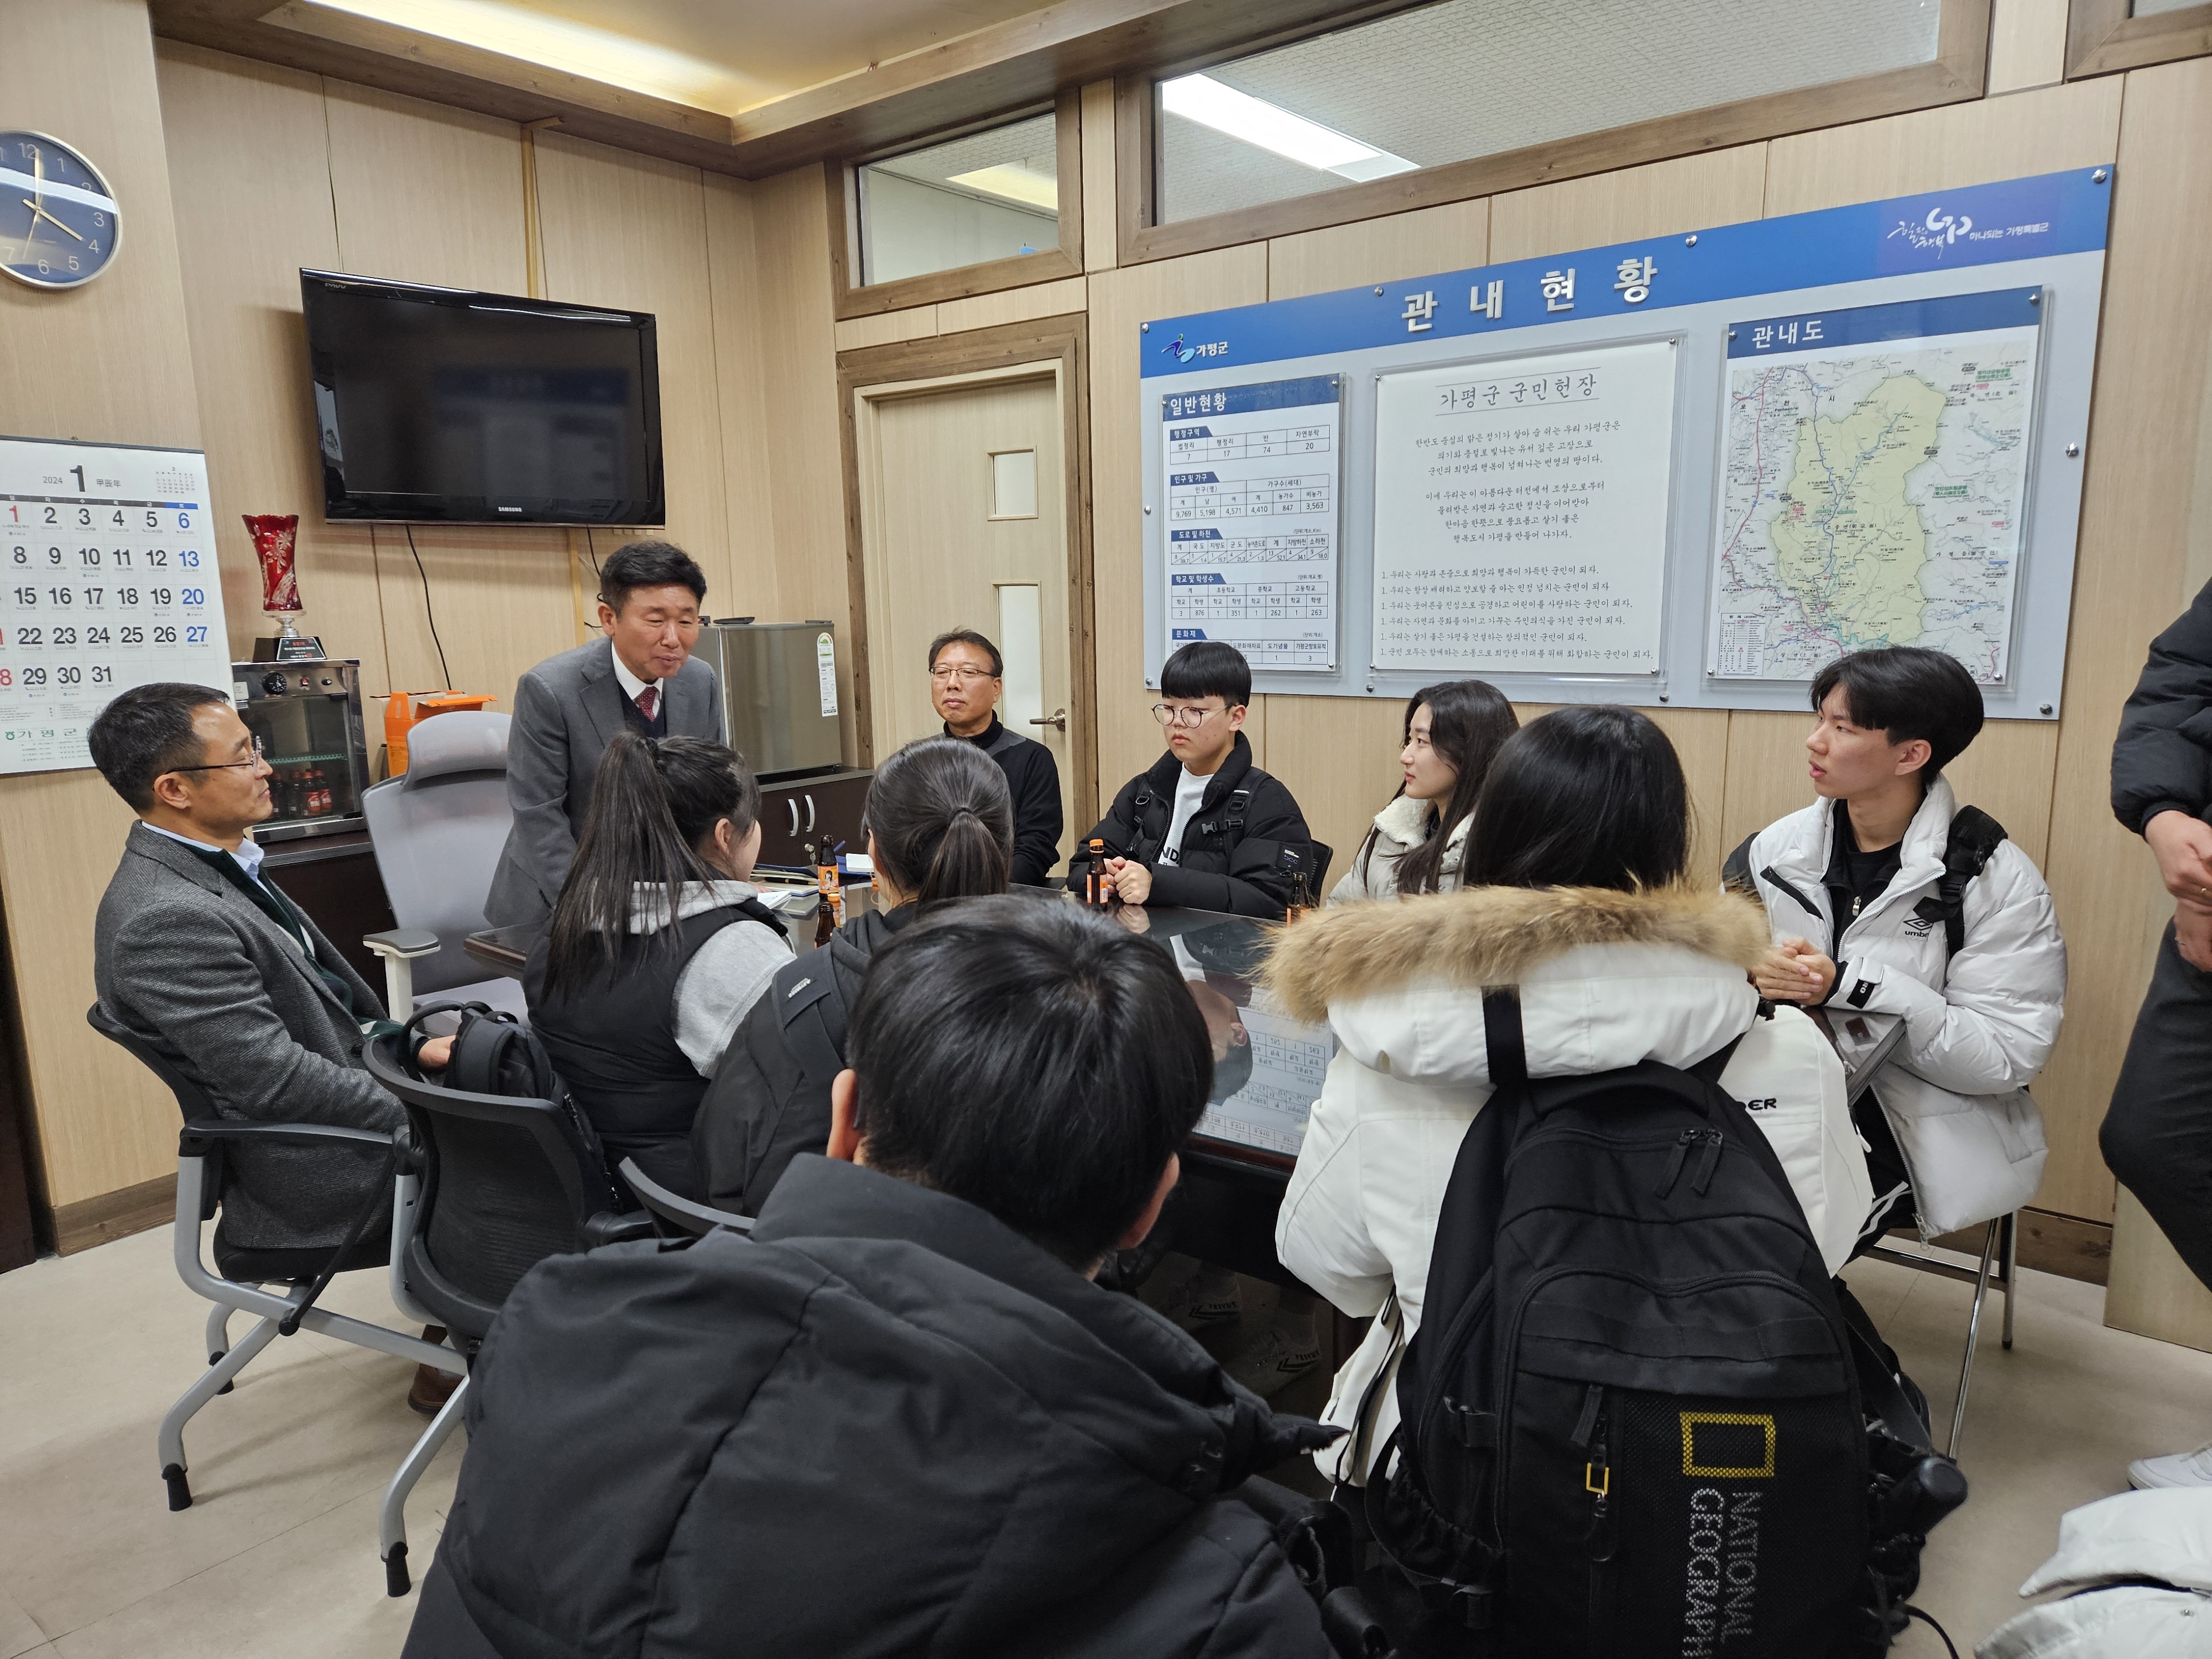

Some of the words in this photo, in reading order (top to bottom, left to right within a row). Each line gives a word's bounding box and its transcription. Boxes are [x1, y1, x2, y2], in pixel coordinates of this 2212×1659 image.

[57, 157, 65, 173] 1
[94, 212, 105, 227] 3
[4, 246, 15, 261] 7
[88, 239, 100, 254] 4
[38, 259, 50, 275] 6
[69, 256, 80, 270] 5
[1752, 320, 1824, 349] 관내도
[1196, 341, 1229, 358] 가평군
[1441, 385, 1500, 410] 가평군
[1509, 373, 1597, 403] 군민헌장
[1170, 392, 1227, 416] 일반현황
[1174, 428, 1199, 439] 행정구역
[1178, 442, 1194, 450] 법정리
[1217, 438, 1233, 447] 행정리
[1296, 429, 1319, 438] 자연부락
[1416, 437, 1438, 448] 한반도
[1441, 434, 1463, 446] 중심의
[1467, 433, 1483, 444] 맑은
[1486, 430, 1511, 442] 정기가
[1514, 428, 1530, 440] 살아
[1532, 427, 1541, 437] 숨
[1543, 426, 1561, 436] 쉬는
[1563, 424, 1580, 434] 우리
[1584, 420, 1621, 432] 가평군은
[1306, 442, 1314, 450] 20
[1437, 450, 1462, 460] 의기와
[1464, 448, 1488, 459] 충절로
[1490, 446, 1516, 456] 빛나는
[1518, 444, 1534, 453] 유서
[1538, 442, 1555, 453] 깊은
[1557, 440, 1593, 450] 고장으로
[1428, 465, 1451, 476] 군민의
[1454, 463, 1478, 474] 희망과
[1481, 461, 1504, 472] 행복이
[1508, 459, 1542, 471] 넘쳐나는
[1545, 456, 1569, 467] 번영의
[1573, 453, 1603, 466] 땅이다.
[43, 476, 62, 484] 2024
[69, 465, 85, 492] 1
[96, 479, 121, 487] 甲辰年
[1175, 475, 1186, 484] 인구
[1195, 473, 1207, 482] 가구
[1195, 486, 1217, 494] 인구(명)
[1267, 478, 1301, 488] 가구수(세대)
[1426, 491, 1440, 500] 이에
[1443, 490, 1467, 500] 우리는
[1469, 489, 1477, 498] 이
[1480, 487, 1513, 498] 아름다운
[1516, 484, 1548, 495] 터전에서
[1552, 481, 1604, 493] 조상으로부터
[1176, 510, 1191, 519] 9,769
[1200, 509, 1215, 517] 5,198
[1225, 507, 1241, 515] 4,571
[1251, 505, 1268, 514] 4,410
[1306, 502, 1323, 511] 3,563
[1437, 504, 1469, 515] 물려받은
[1472, 503, 1496, 513] 자연과
[1498, 501, 1524, 512] 숭고한
[1526, 499, 1551, 510] 정신을
[1554, 497, 1589, 508] 이어받아
[9, 505, 18, 523] 1
[44, 506, 58, 524] 2
[79, 508, 91, 525] 3
[112, 510, 124, 526] 4
[146, 511, 158, 528] 5
[178, 512, 190, 529] 6
[1445, 519, 1469, 529] 한마음
[1471, 518, 1504, 528] 한뜻으로
[1506, 515, 1540, 526] 풍요롭고
[1542, 514, 1558, 525] 살기
[1562, 513, 1579, 524] 좋은
[1192, 530, 1197, 539] 및
[1199, 530, 1211, 538] 하천
[1453, 533, 1484, 544] 행복도시
[1488, 532, 1512, 542] 가평을
[1515, 530, 1539, 541] 만들어
[1543, 529, 1572, 539] 나가자.
[13, 546, 27, 564] 8
[49, 546, 61, 565] 9
[79, 547, 101, 565] 10
[113, 549, 132, 566] 11
[146, 549, 168, 566] 12
[179, 550, 200, 567] 13
[1176, 575, 1187, 583] 학교
[1188, 575, 1194, 583] 및
[1196, 575, 1214, 583] 학생수
[1390, 570, 1412, 579] 우리는
[1415, 569, 1437, 579] 사랑과
[1438, 569, 1469, 578] 존중으로
[1472, 567, 1495, 577] 희망과
[1498, 567, 1520, 577] 행복이
[1524, 566, 1549, 576] 가득한
[1551, 565, 1575, 576] 군민이
[1579, 565, 1599, 575] 되자.
[14, 587, 37, 604] 15
[48, 587, 72, 604] 16
[83, 588, 104, 604] 17
[117, 588, 139, 604] 18
[150, 588, 171, 605] 19
[181, 588, 205, 605] 20
[17, 627, 43, 645] 22
[53, 627, 77, 644] 23
[87, 627, 111, 644] 24
[120, 627, 144, 643] 25
[153, 626, 177, 643] 26
[186, 626, 207, 642] 27
[1176, 629, 1196, 638] 문화재
[0, 669, 13, 686] 8
[23, 667, 47, 685] 29
[57, 666, 81, 684] 30
[91, 666, 112, 682] 31
[1681, 1488, 1725, 1658] GEOGRAPH
[1720, 1492, 1763, 1645] NATIONAL
